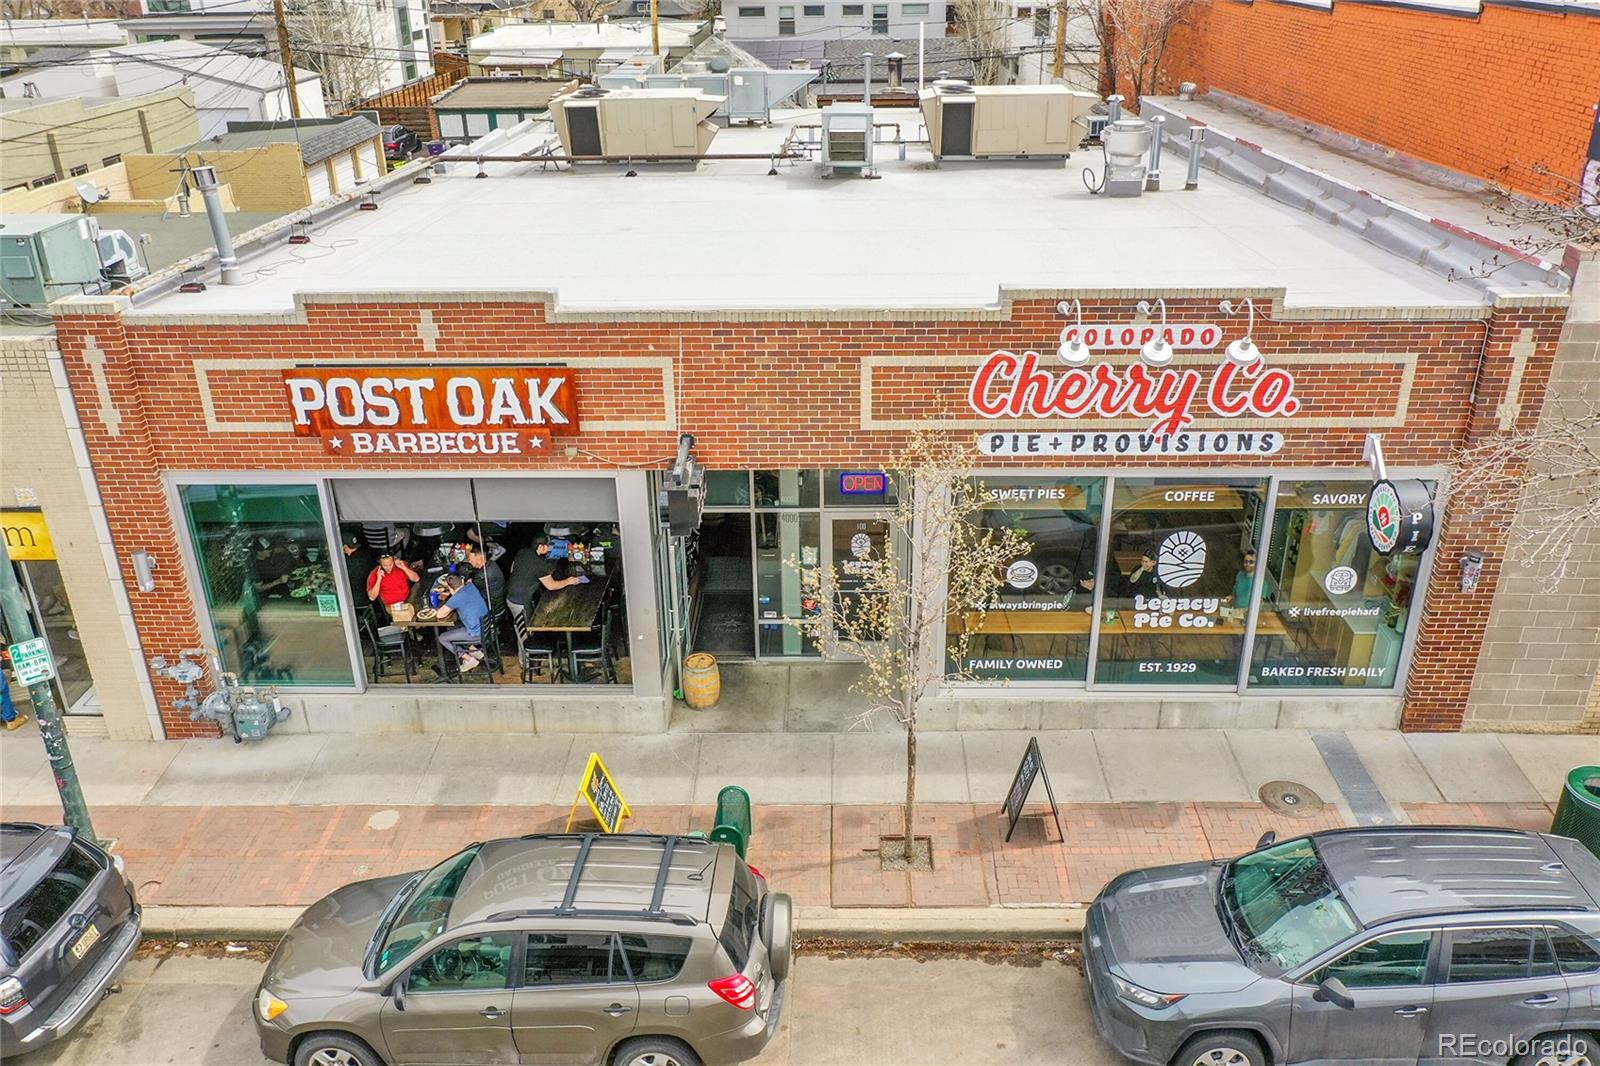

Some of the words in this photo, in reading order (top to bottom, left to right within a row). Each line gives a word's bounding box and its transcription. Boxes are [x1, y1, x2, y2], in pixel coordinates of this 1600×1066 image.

[1066, 328, 1215, 347] COLORADO
[285, 377, 435, 425] POST
[446, 377, 570, 425] OAK
[970, 352, 1199, 444] Cherry
[1211, 357, 1297, 413] Co.
[350, 432, 521, 454] BARBECUE
[843, 475, 884, 492] OPEN
[991, 488, 1035, 500] SWEET
[1037, 488, 1066, 500] PIES
[1164, 491, 1216, 502] COFFEE
[1312, 493, 1367, 505] SAVORY
[1134, 594, 1219, 613] Legacy
[1134, 612, 1173, 628] Pie
[1179, 613, 1215, 628] Co.
[12, 649, 21, 661] 2
[26, 642, 36, 650] HR
[22, 648, 47, 659] PARKING
[969, 659, 1014, 669] FAMILY
[1016, 659, 1063, 670] OWNED
[1138, 662, 1163, 672] EST.
[1166, 662, 1197, 673] 1929
[1261, 667, 1304, 677] BAKED
[1306, 667, 1346, 677] FRESH
[1348, 667, 1386, 677] DAILY
